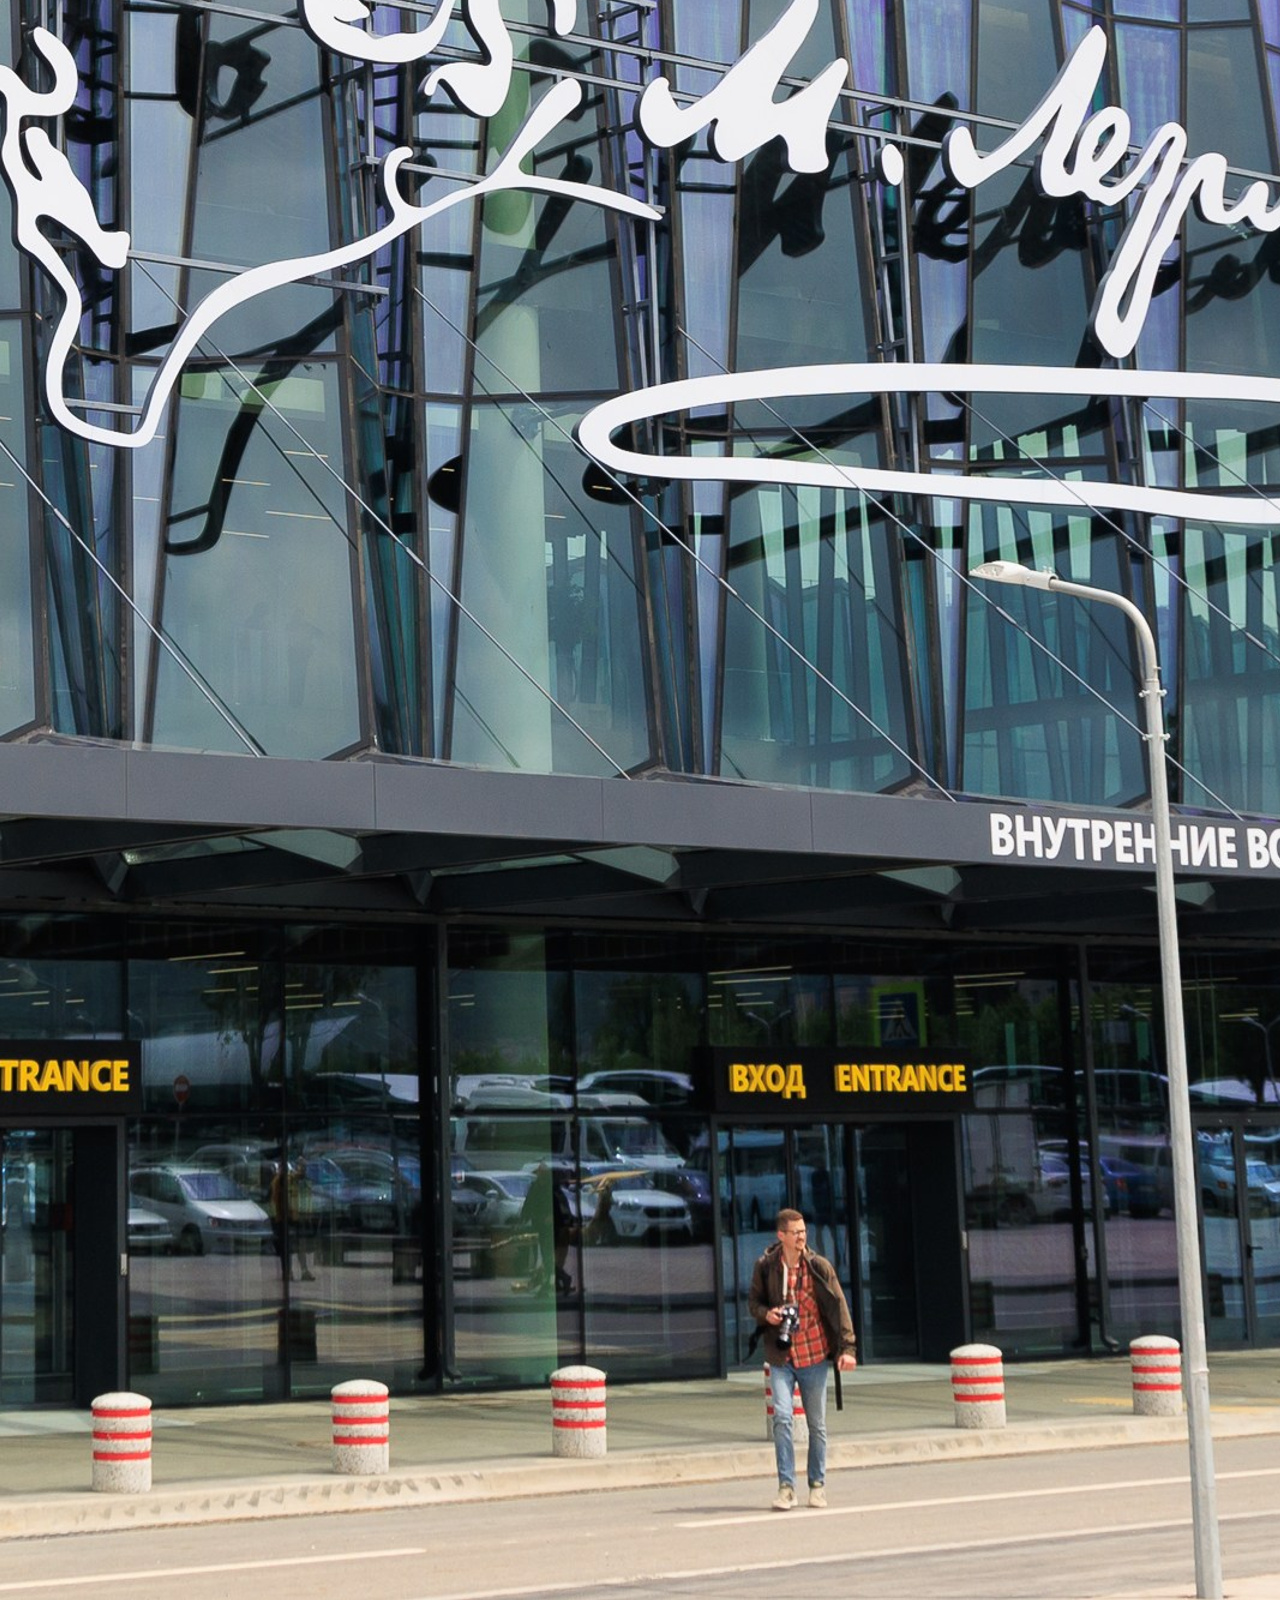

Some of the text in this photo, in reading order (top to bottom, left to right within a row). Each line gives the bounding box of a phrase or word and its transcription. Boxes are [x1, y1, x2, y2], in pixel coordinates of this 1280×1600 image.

[989, 812, 1238, 868] ВНУТРЕННИЕ
[729, 1064, 967, 1099] ВХОД ENTRANCE
